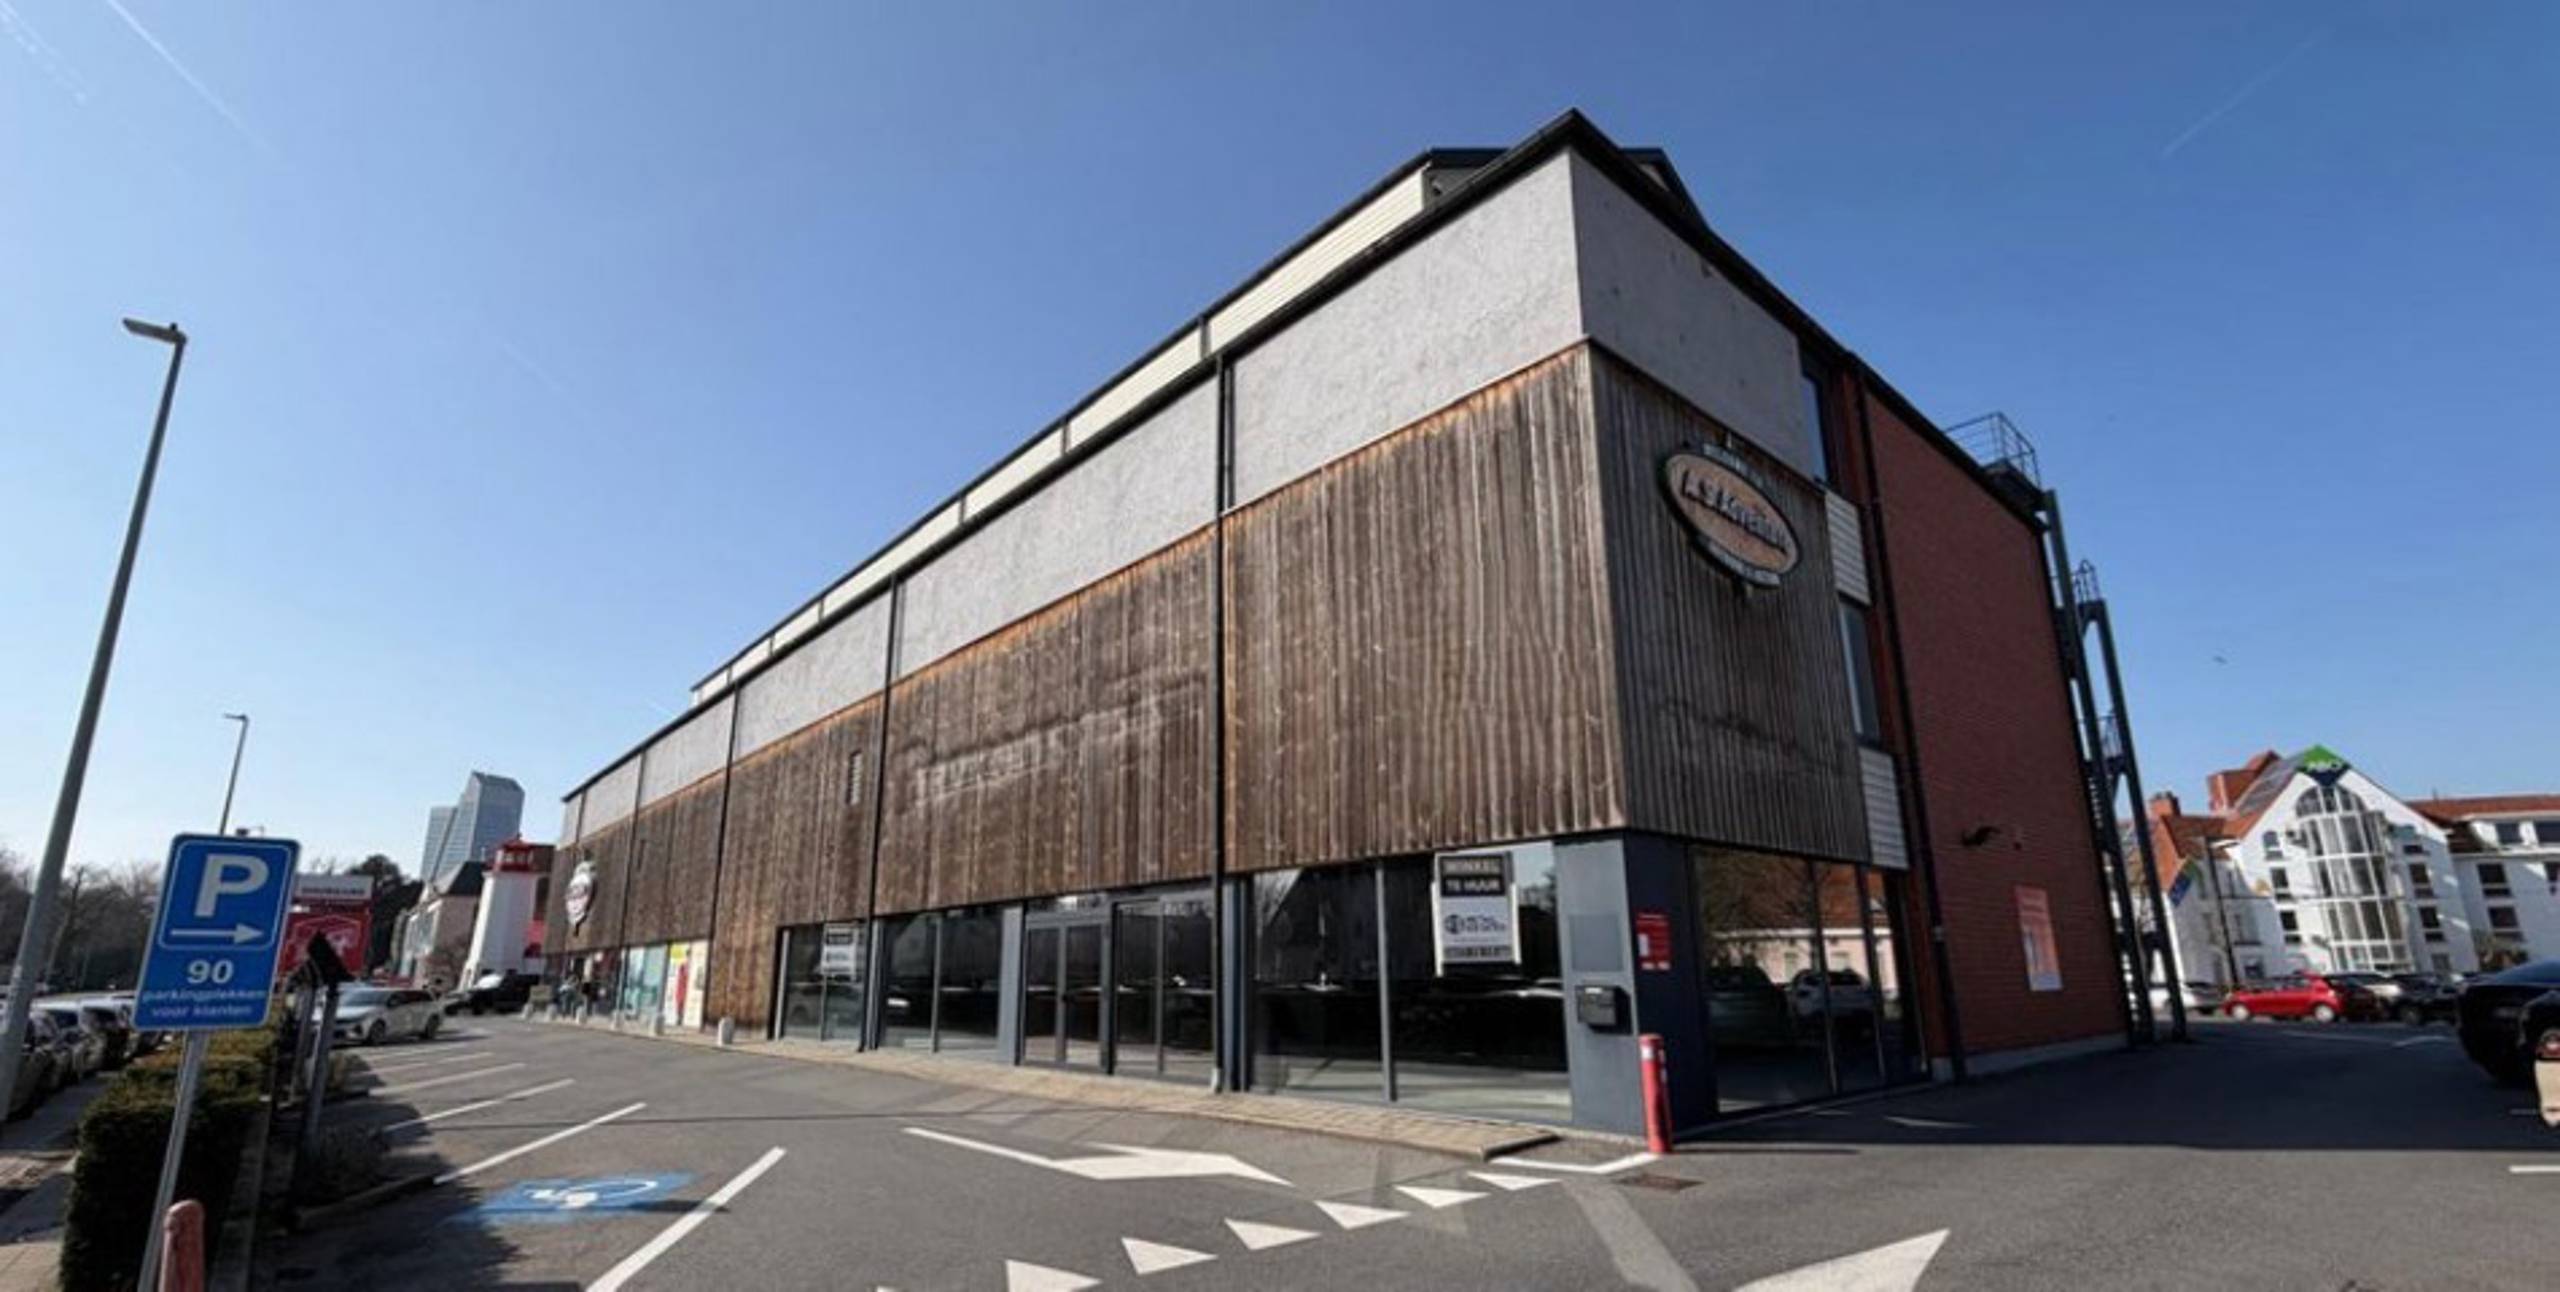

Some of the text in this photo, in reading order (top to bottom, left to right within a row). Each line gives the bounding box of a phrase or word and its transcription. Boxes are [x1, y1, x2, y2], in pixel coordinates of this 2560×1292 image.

[1443, 859, 1500, 875] WINKEL
[195, 853, 269, 917] P
[1446, 879, 1500, 892] TE HUUR
[186, 959, 235, 984] 90
[142, 989, 267, 1004] parkingplekken
[152, 1004, 253, 1017] voor klanten
